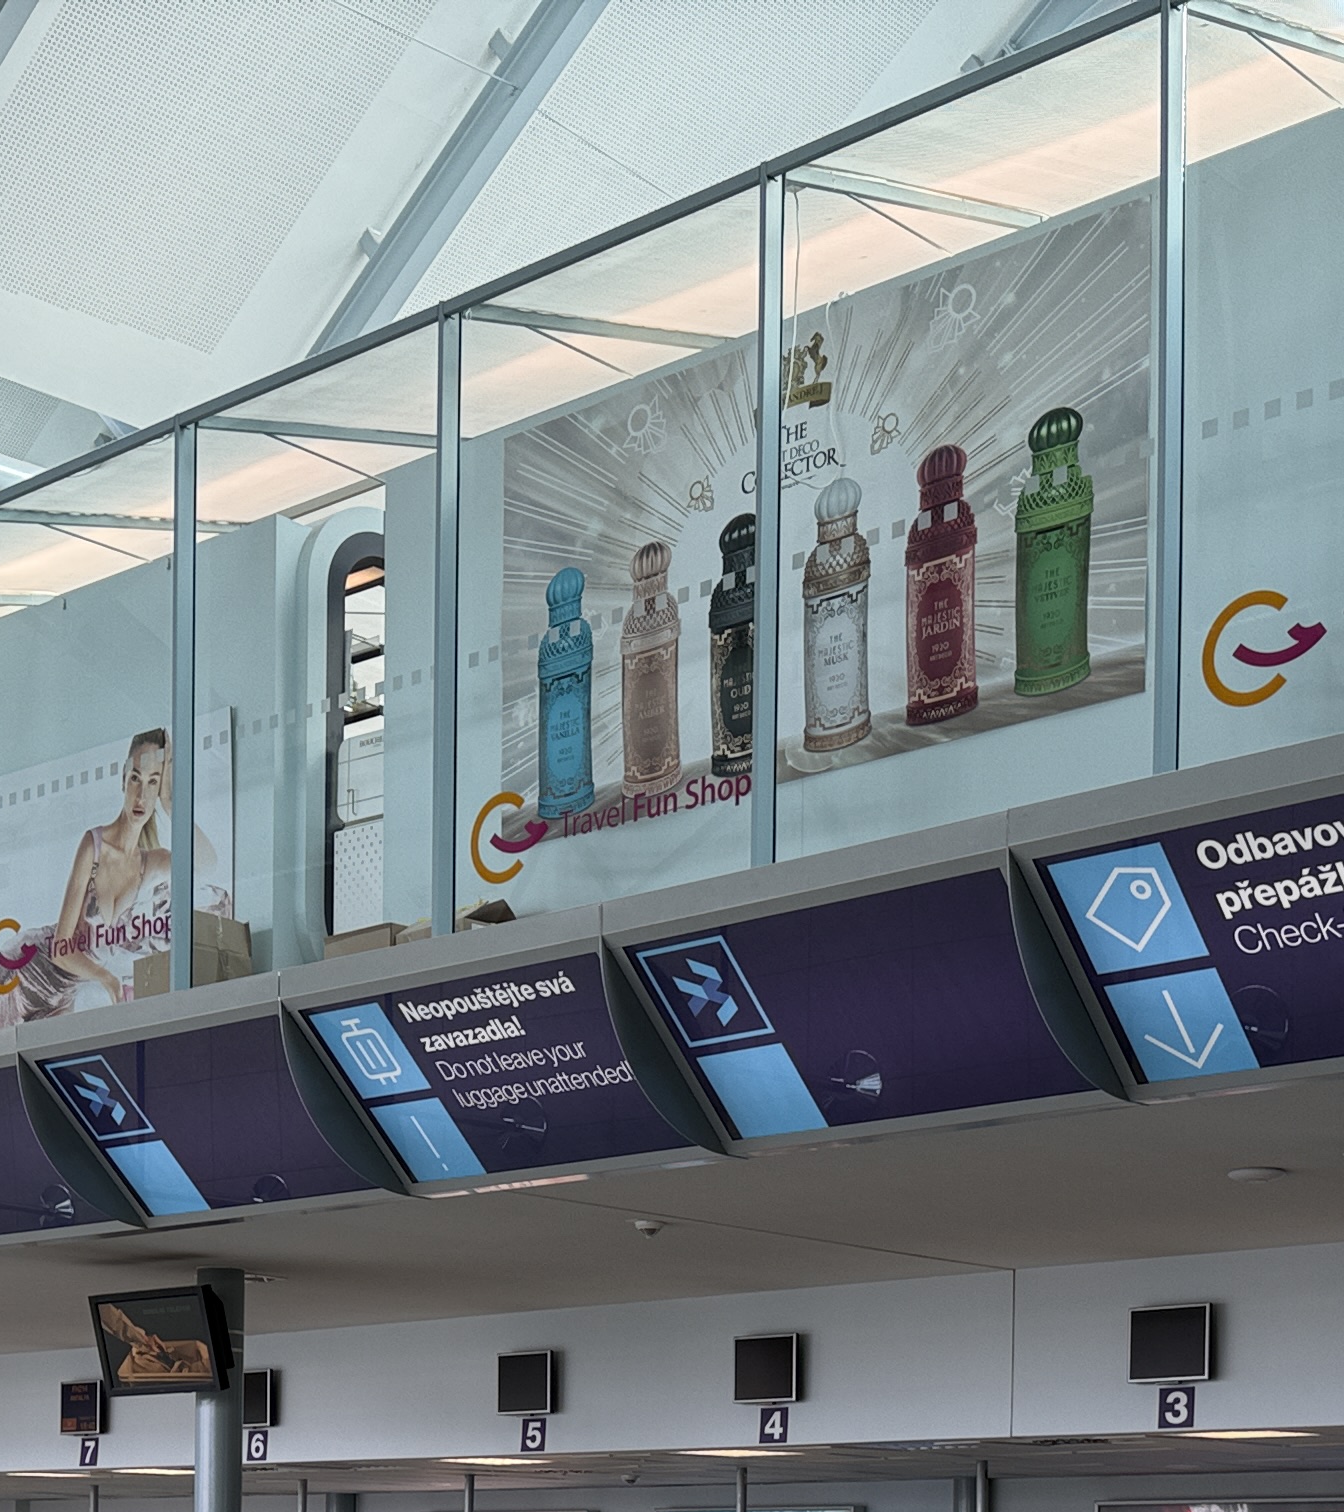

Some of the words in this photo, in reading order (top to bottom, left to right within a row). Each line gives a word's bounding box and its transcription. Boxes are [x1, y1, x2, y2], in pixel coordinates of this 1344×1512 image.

[790, 439, 820, 460] DECO
[921, 607, 961, 627] MAJESTIC
[934, 598, 949, 611] THE
[830, 632, 843, 645] THE
[922, 617, 961, 640] JARDIN
[818, 640, 855, 658] MAJESTIC
[824, 655, 849, 667] MUSK
[730, 684, 752, 698] OUD
[559, 797, 625, 837] Travel
[633, 792, 678, 822] Fun
[685, 774, 752, 809] Shop
[45, 926, 91, 959] Travel
[96, 924, 126, 948] Fun
[398, 979, 536, 1023] Neopouštějte
[539, 970, 576, 996] svá
[420, 1015, 526, 1053] zavazadla!
[435, 1060, 468, 1082] Do
[466, 1054, 499, 1077] not
[493, 1050, 546, 1072] leave
[545, 1041, 587, 1067] your
[452, 1080, 527, 1110] luggage
[526, 1059, 636, 1097] unattended!
[1165, 1391, 1189, 1424] 3
[525, 1422, 542, 1448] 5
[763, 1411, 783, 1439] 4
[83, 1440, 96, 1464] 7
[250, 1433, 265, 1459] 6
